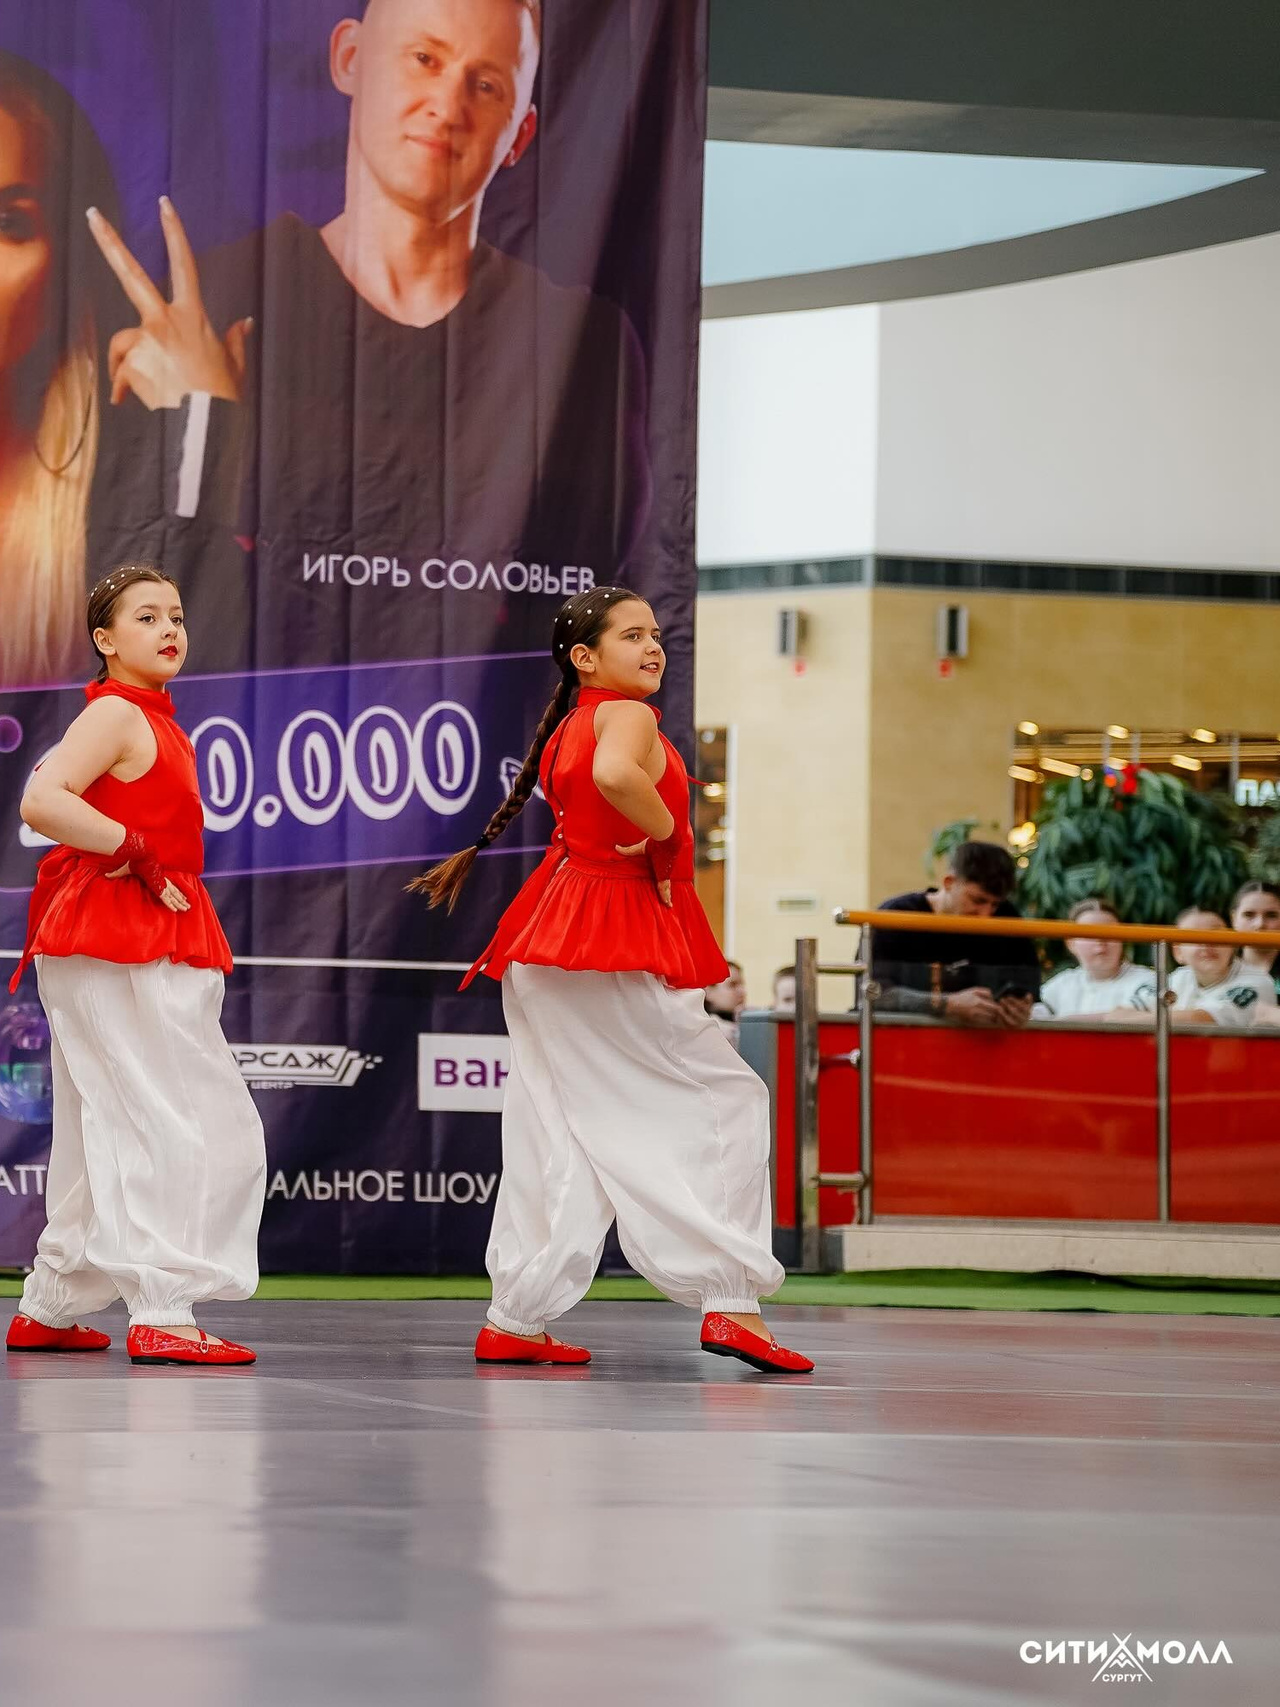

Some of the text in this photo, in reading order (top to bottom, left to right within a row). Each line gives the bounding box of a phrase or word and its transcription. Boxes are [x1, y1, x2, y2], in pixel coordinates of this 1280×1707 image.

[303, 553, 596, 596] ИГОРЬ СОЛОВЬЕВ
[232, 1051, 335, 1069] РСАЖ
[266, 1169, 498, 1205] АЛЬНОЕ ШОУ
